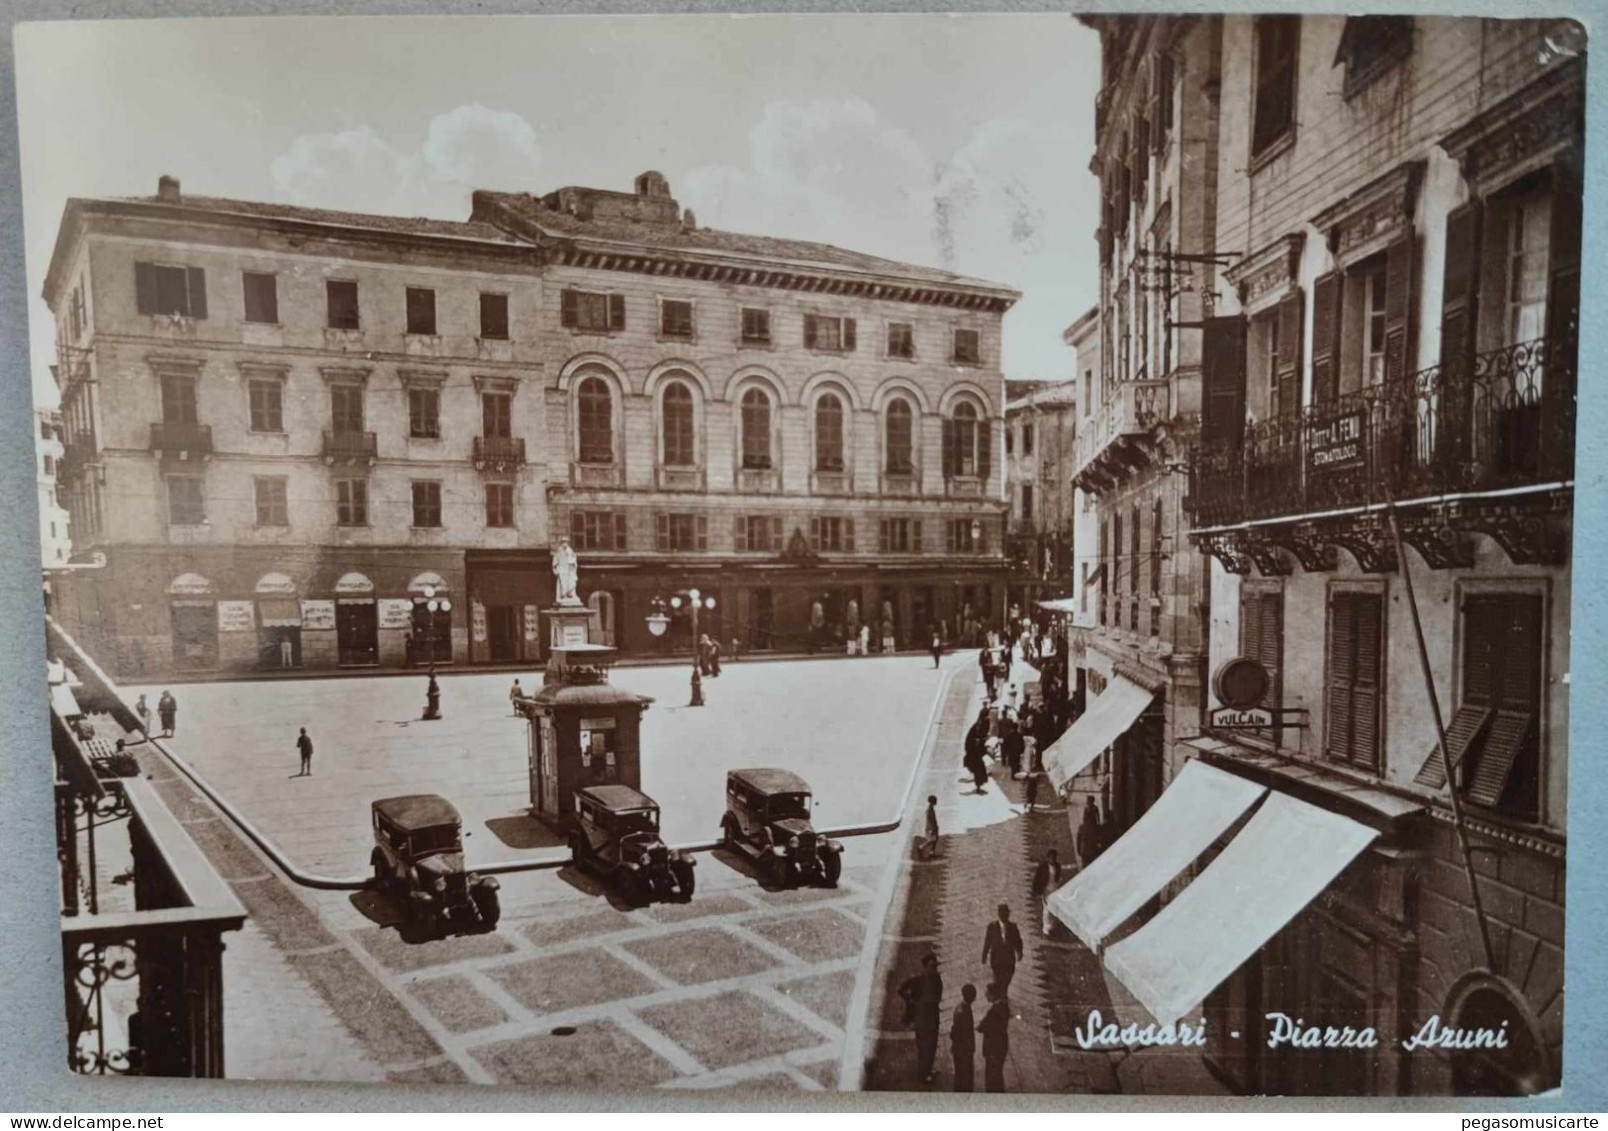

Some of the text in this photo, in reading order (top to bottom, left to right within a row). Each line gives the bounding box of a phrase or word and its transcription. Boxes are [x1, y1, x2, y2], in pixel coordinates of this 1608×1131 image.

[1339, 415, 1360, 442] FENU
[1313, 443, 1357, 466] STOMATOLOGO
[1218, 711, 1266, 725] VULCAIN
[1075, 1009, 1207, 1049] Sassari
[1265, 1012, 1378, 1048] Piazza
[1402, 1014, 1509, 1051] Azuni
